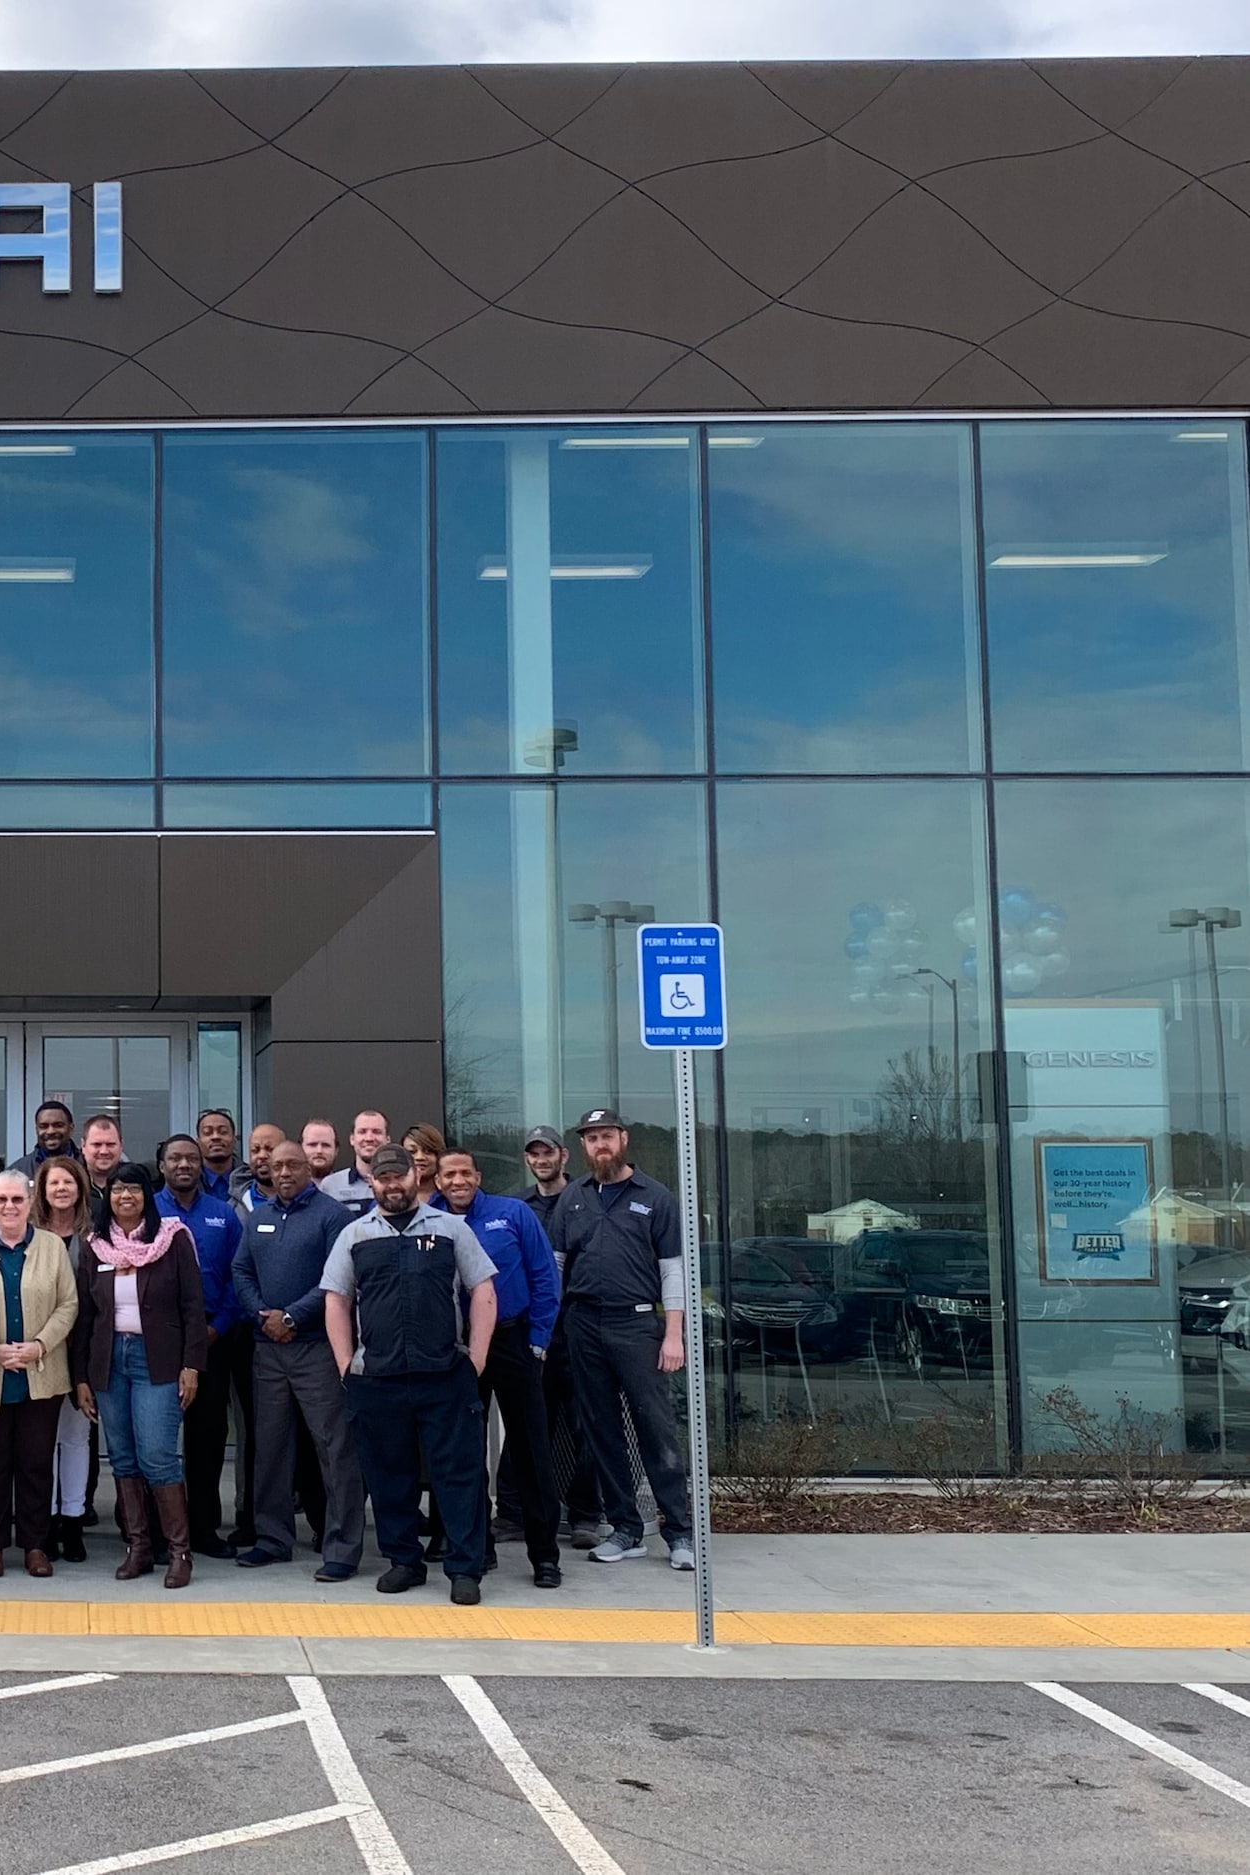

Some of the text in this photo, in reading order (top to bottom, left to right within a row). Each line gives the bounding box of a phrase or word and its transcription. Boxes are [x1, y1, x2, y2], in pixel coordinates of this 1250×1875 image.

[644, 937, 716, 947] PERMIT PARKING ONLY
[656, 955, 707, 965] TOW-AWAY ZONE
[645, 1026, 676, 1036] MAXIMUM
[677, 1026, 692, 1036] FINE
[1025, 1050, 1155, 1068] GENESIS
[1053, 1169, 1136, 1177] Get the best deals in
[1070, 1180, 1101, 1189] 30-year
[1102, 1179, 1131, 1189] history
[1054, 1190, 1082, 1198] before
[1076, 1234, 1121, 1249] BETTER
